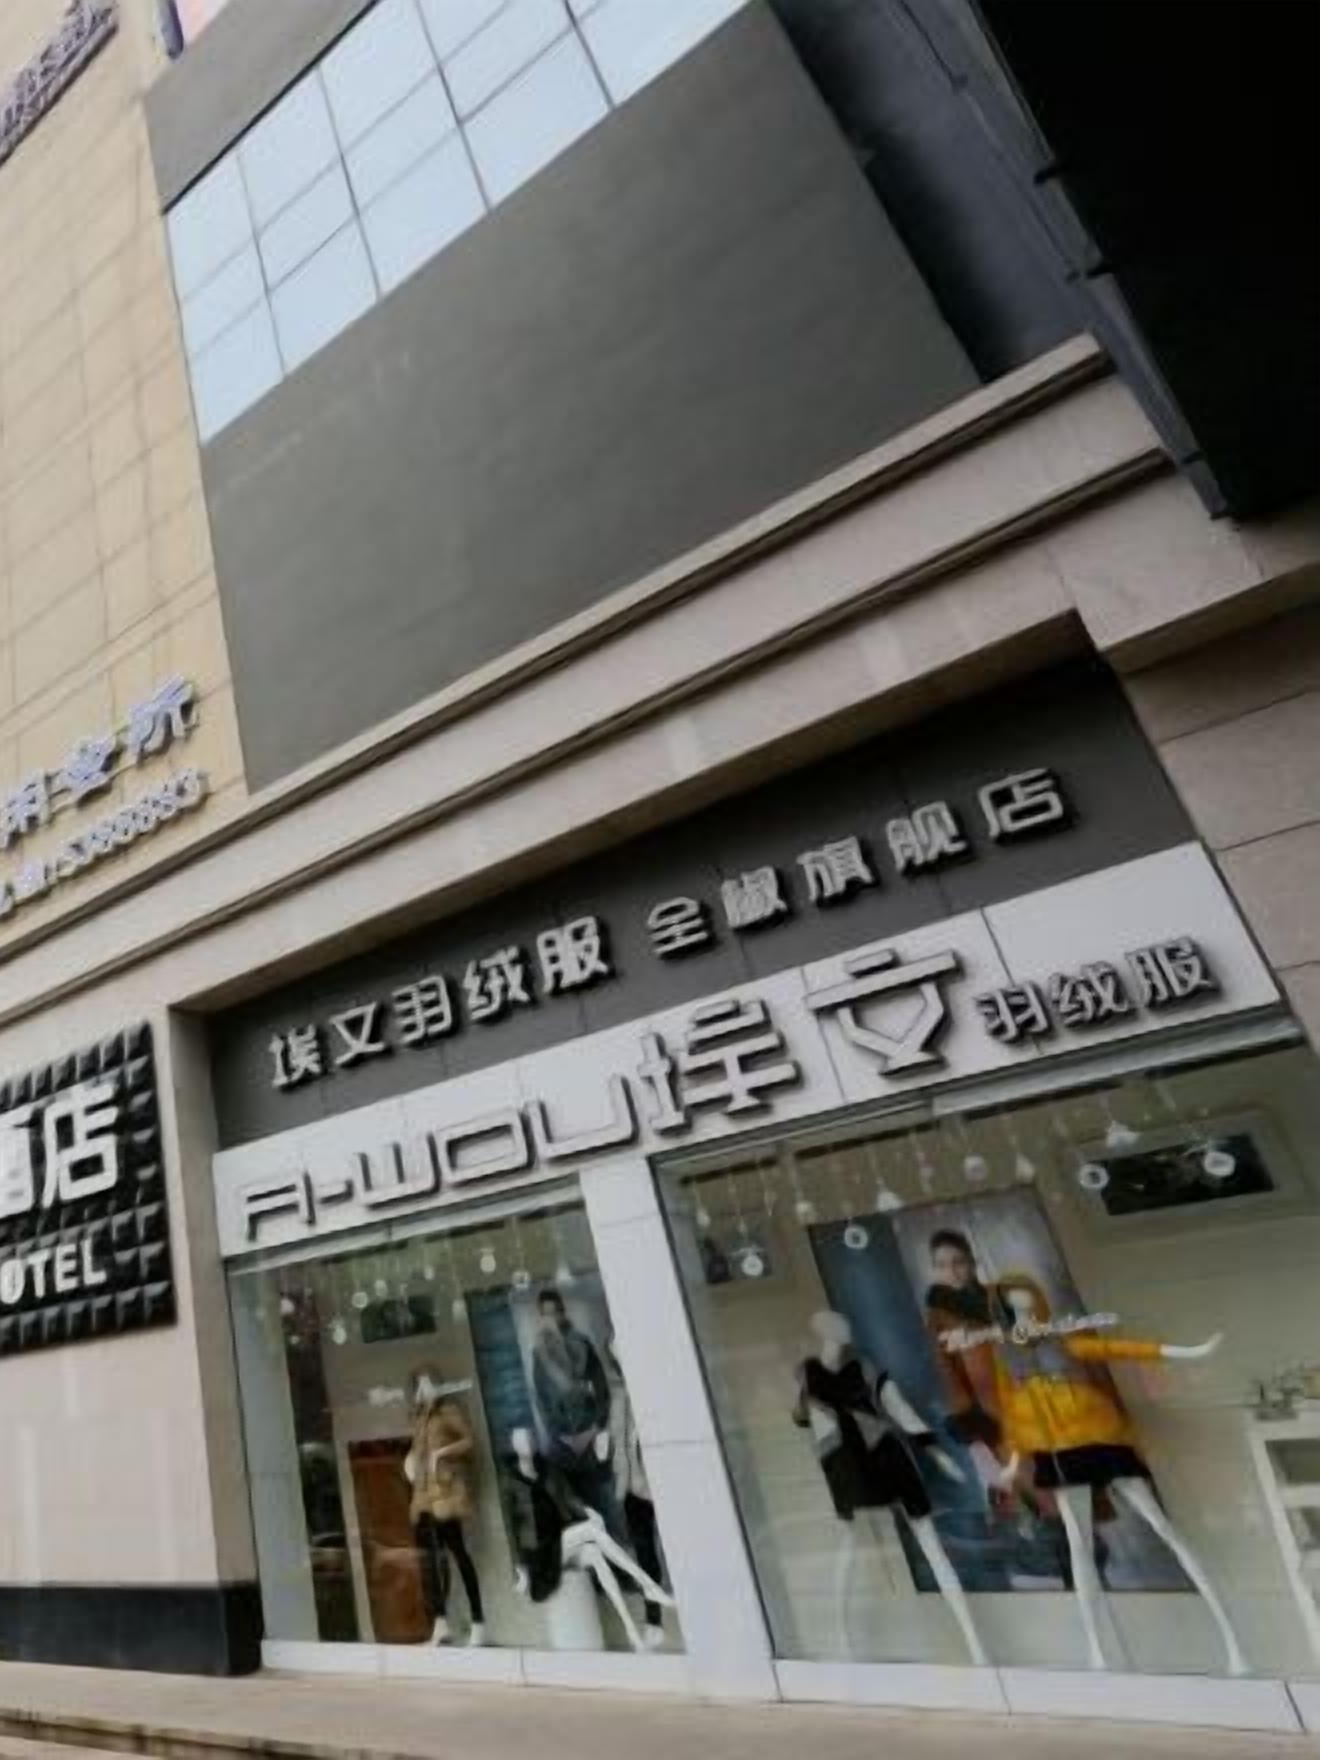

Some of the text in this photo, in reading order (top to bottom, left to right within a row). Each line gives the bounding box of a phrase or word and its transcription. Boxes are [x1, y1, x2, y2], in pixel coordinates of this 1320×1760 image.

[647, 768, 1065, 957] 全椒旗舰店
[269, 916, 610, 1087] 埃文羽绒服
[973, 935, 1214, 1042] 羽绒服
